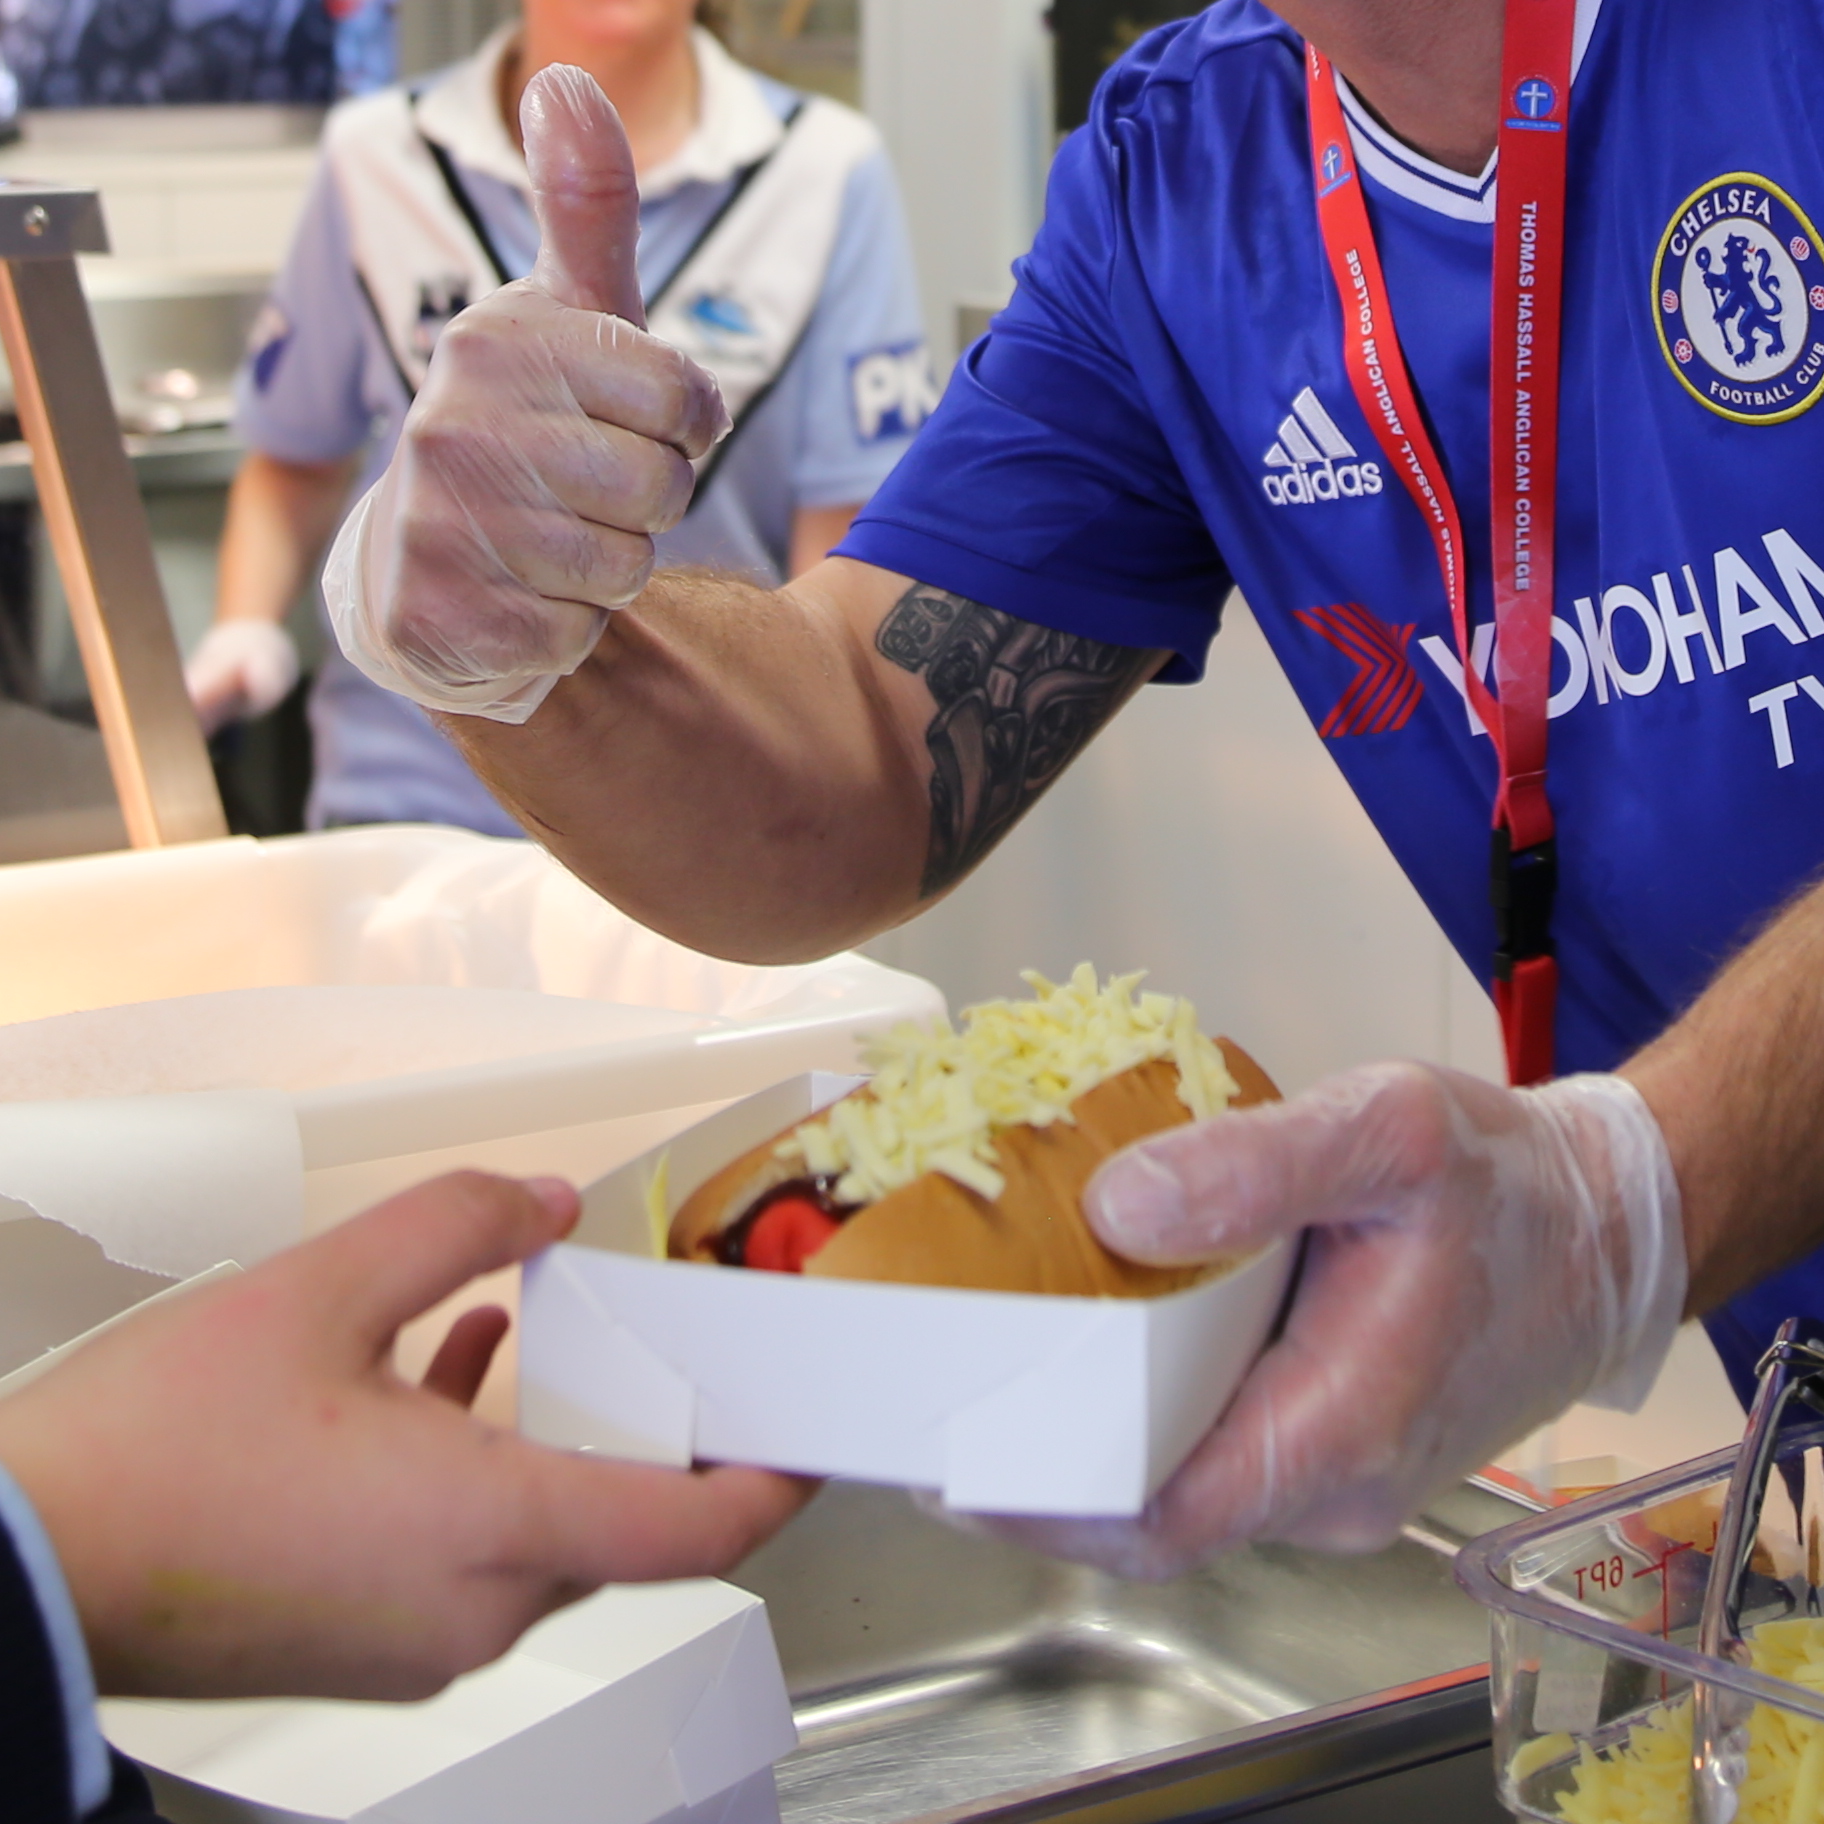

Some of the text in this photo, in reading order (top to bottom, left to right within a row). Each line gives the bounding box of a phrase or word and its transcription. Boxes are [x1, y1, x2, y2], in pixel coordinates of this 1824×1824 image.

[1670, 189, 1771, 257] CHELSEA
[1346, 249, 1372, 335] COLLEGE
[1362, 338, 1404, 436] ANGLICAN
[1515, 201, 1537, 591] THOMAS HASSALL ANGLICAN COLLEGE
[1710, 380, 1794, 406] FOOTBALL
[1263, 458, 1383, 506] adidas
[1393, 440, 1445, 524] HASSALL
